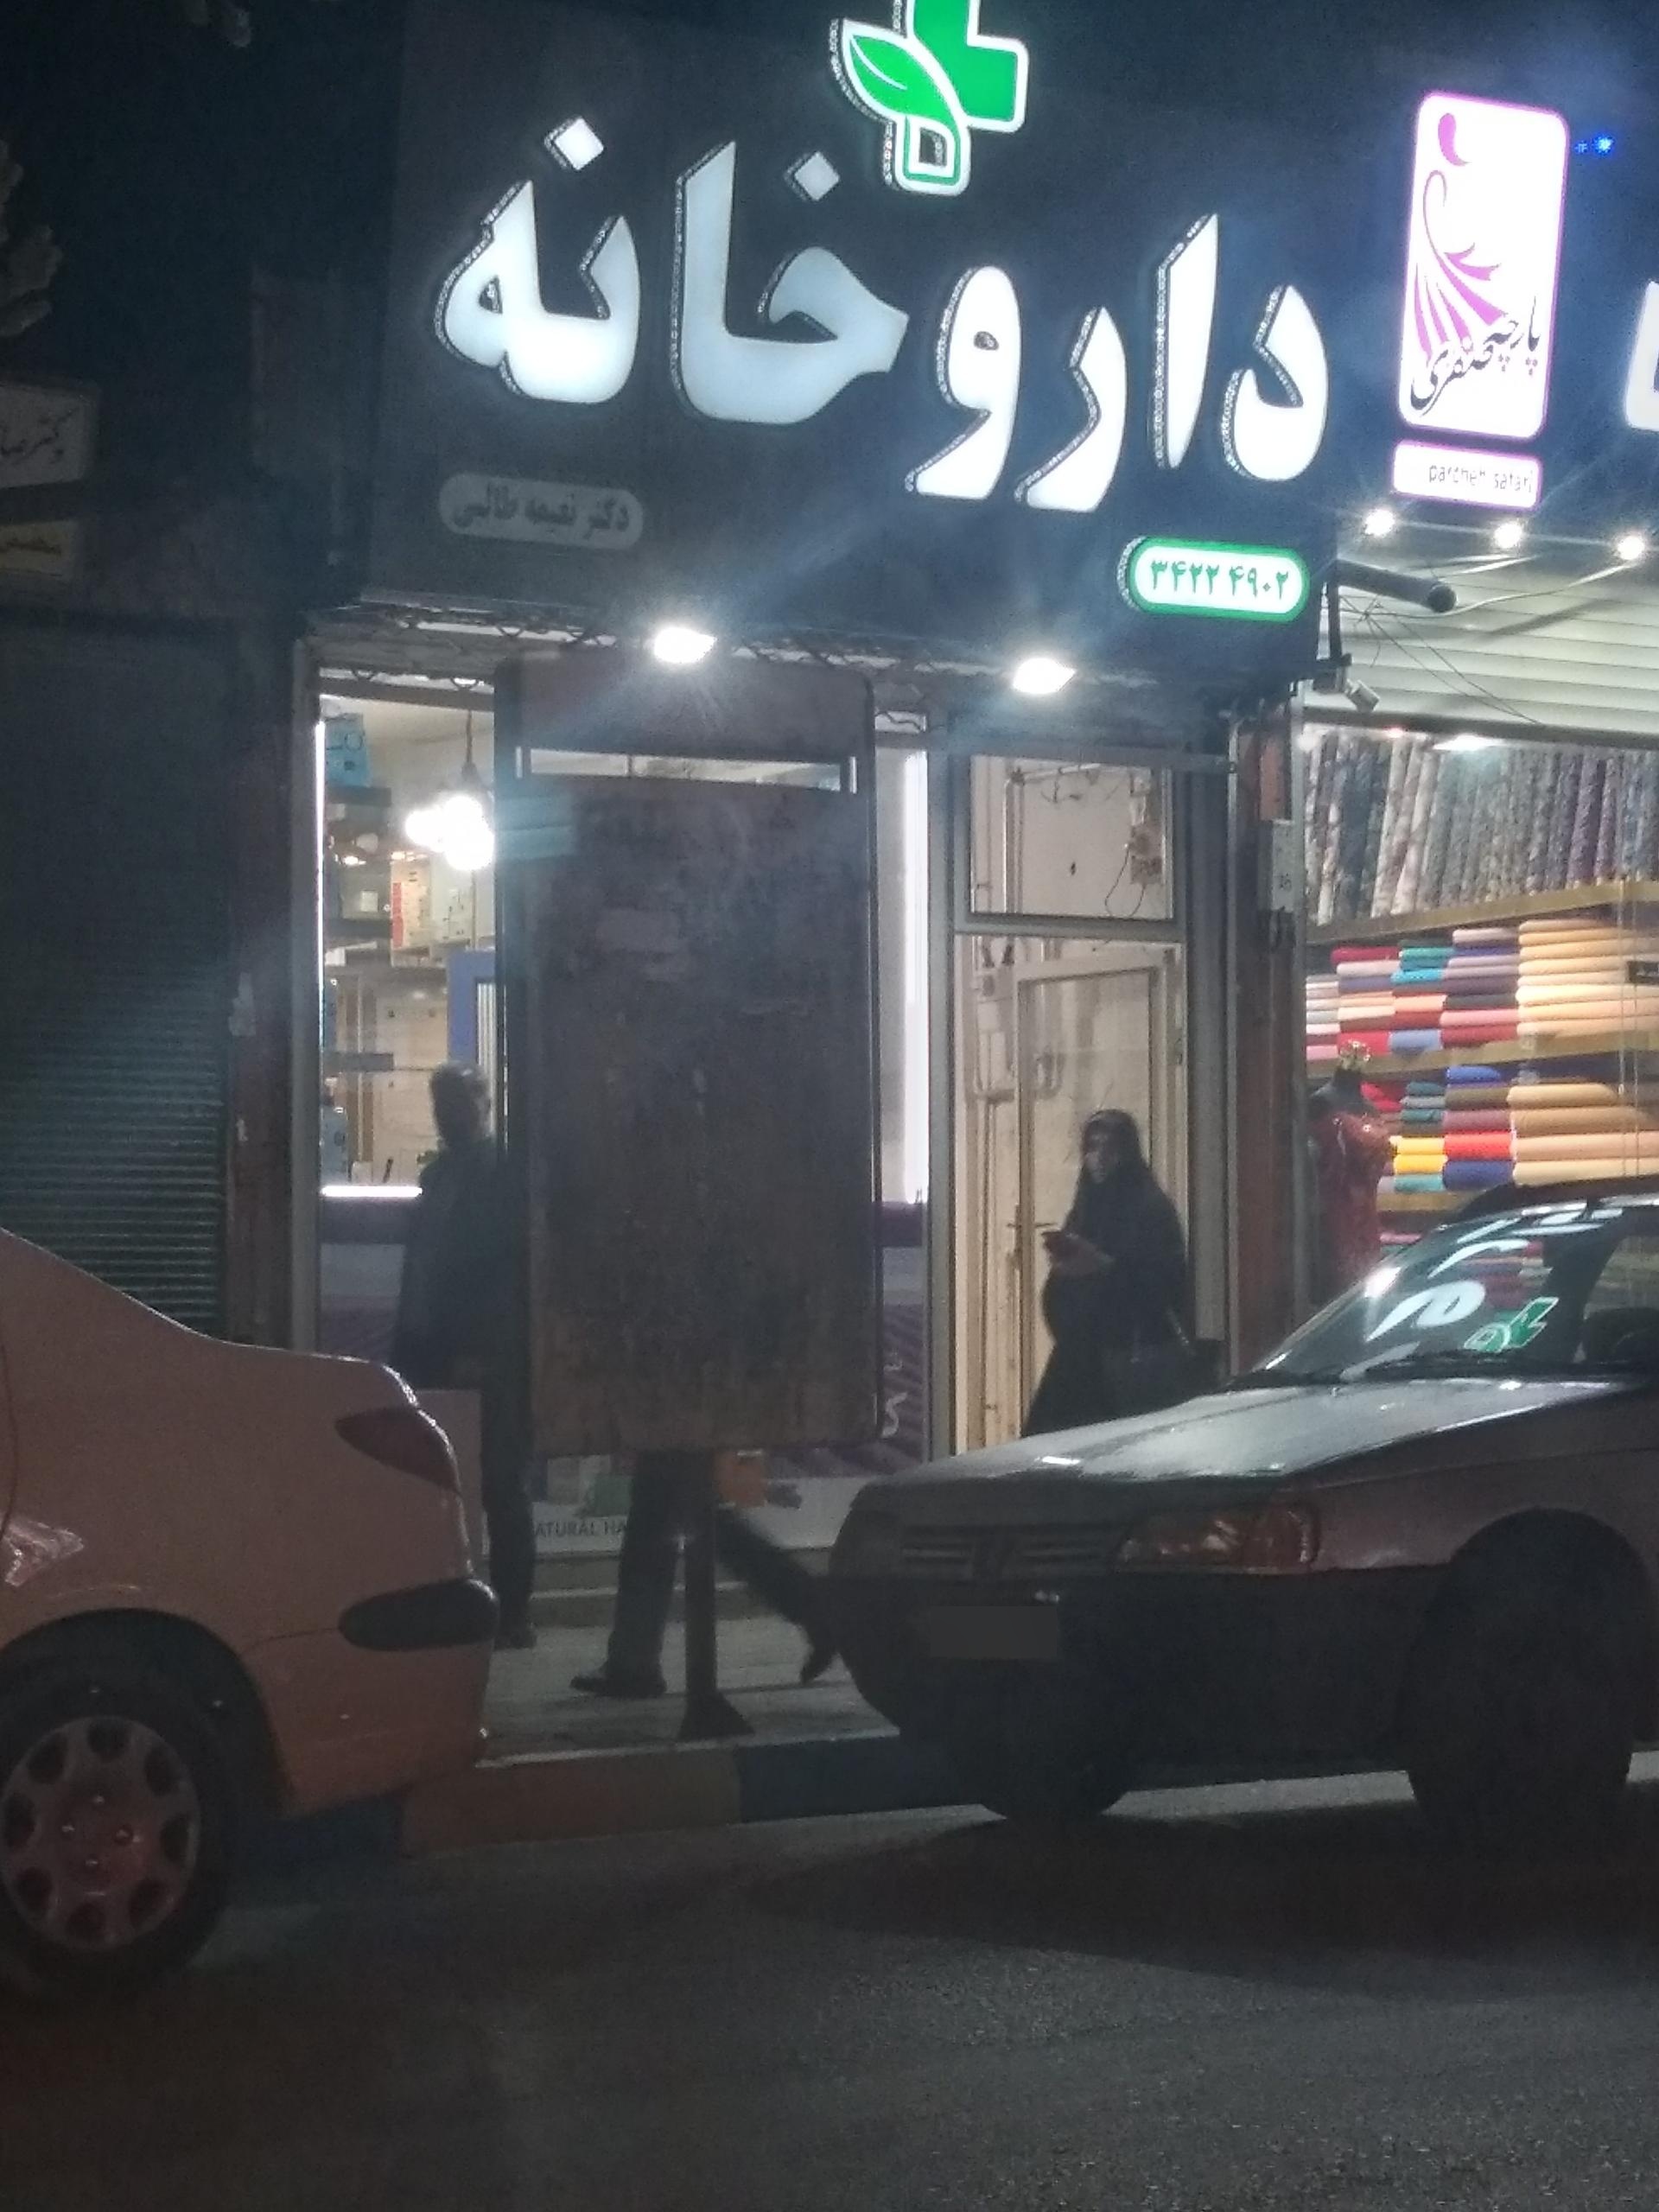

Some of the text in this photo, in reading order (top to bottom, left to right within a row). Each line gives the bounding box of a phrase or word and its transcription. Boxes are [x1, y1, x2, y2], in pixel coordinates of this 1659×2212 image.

[435, 117, 1330, 512] داروخانه
[582, 496, 631, 540] دکتر
[1150, 559, 1220, 595] ۳۴۲۲
[534, 1521, 596, 1538] ATURAL
